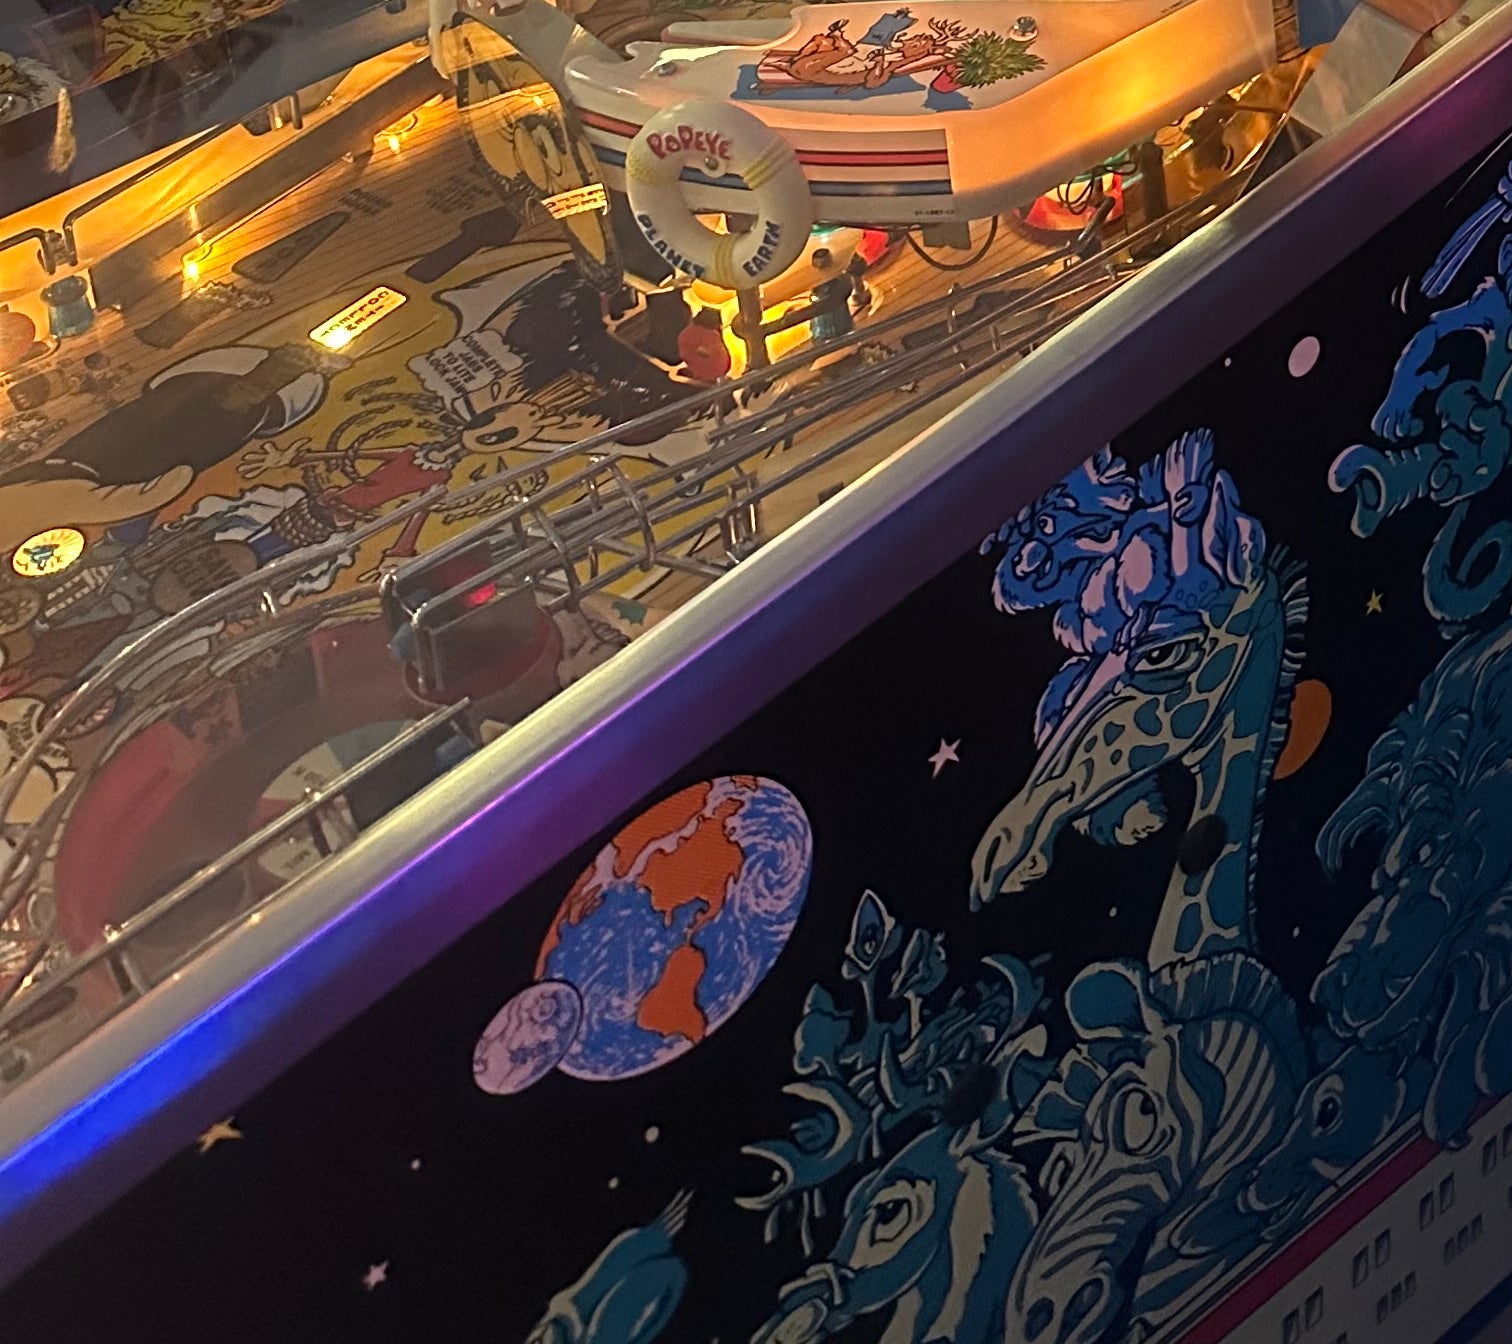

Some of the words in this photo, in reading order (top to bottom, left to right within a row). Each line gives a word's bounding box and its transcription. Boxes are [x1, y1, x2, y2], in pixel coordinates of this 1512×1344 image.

[646, 125, 733, 160] POPEYE
[637, 214, 705, 277] PLANET
[742, 220, 781, 276] EARTH
[443, 352, 457, 365] TO
[453, 364, 476, 384] LITE
